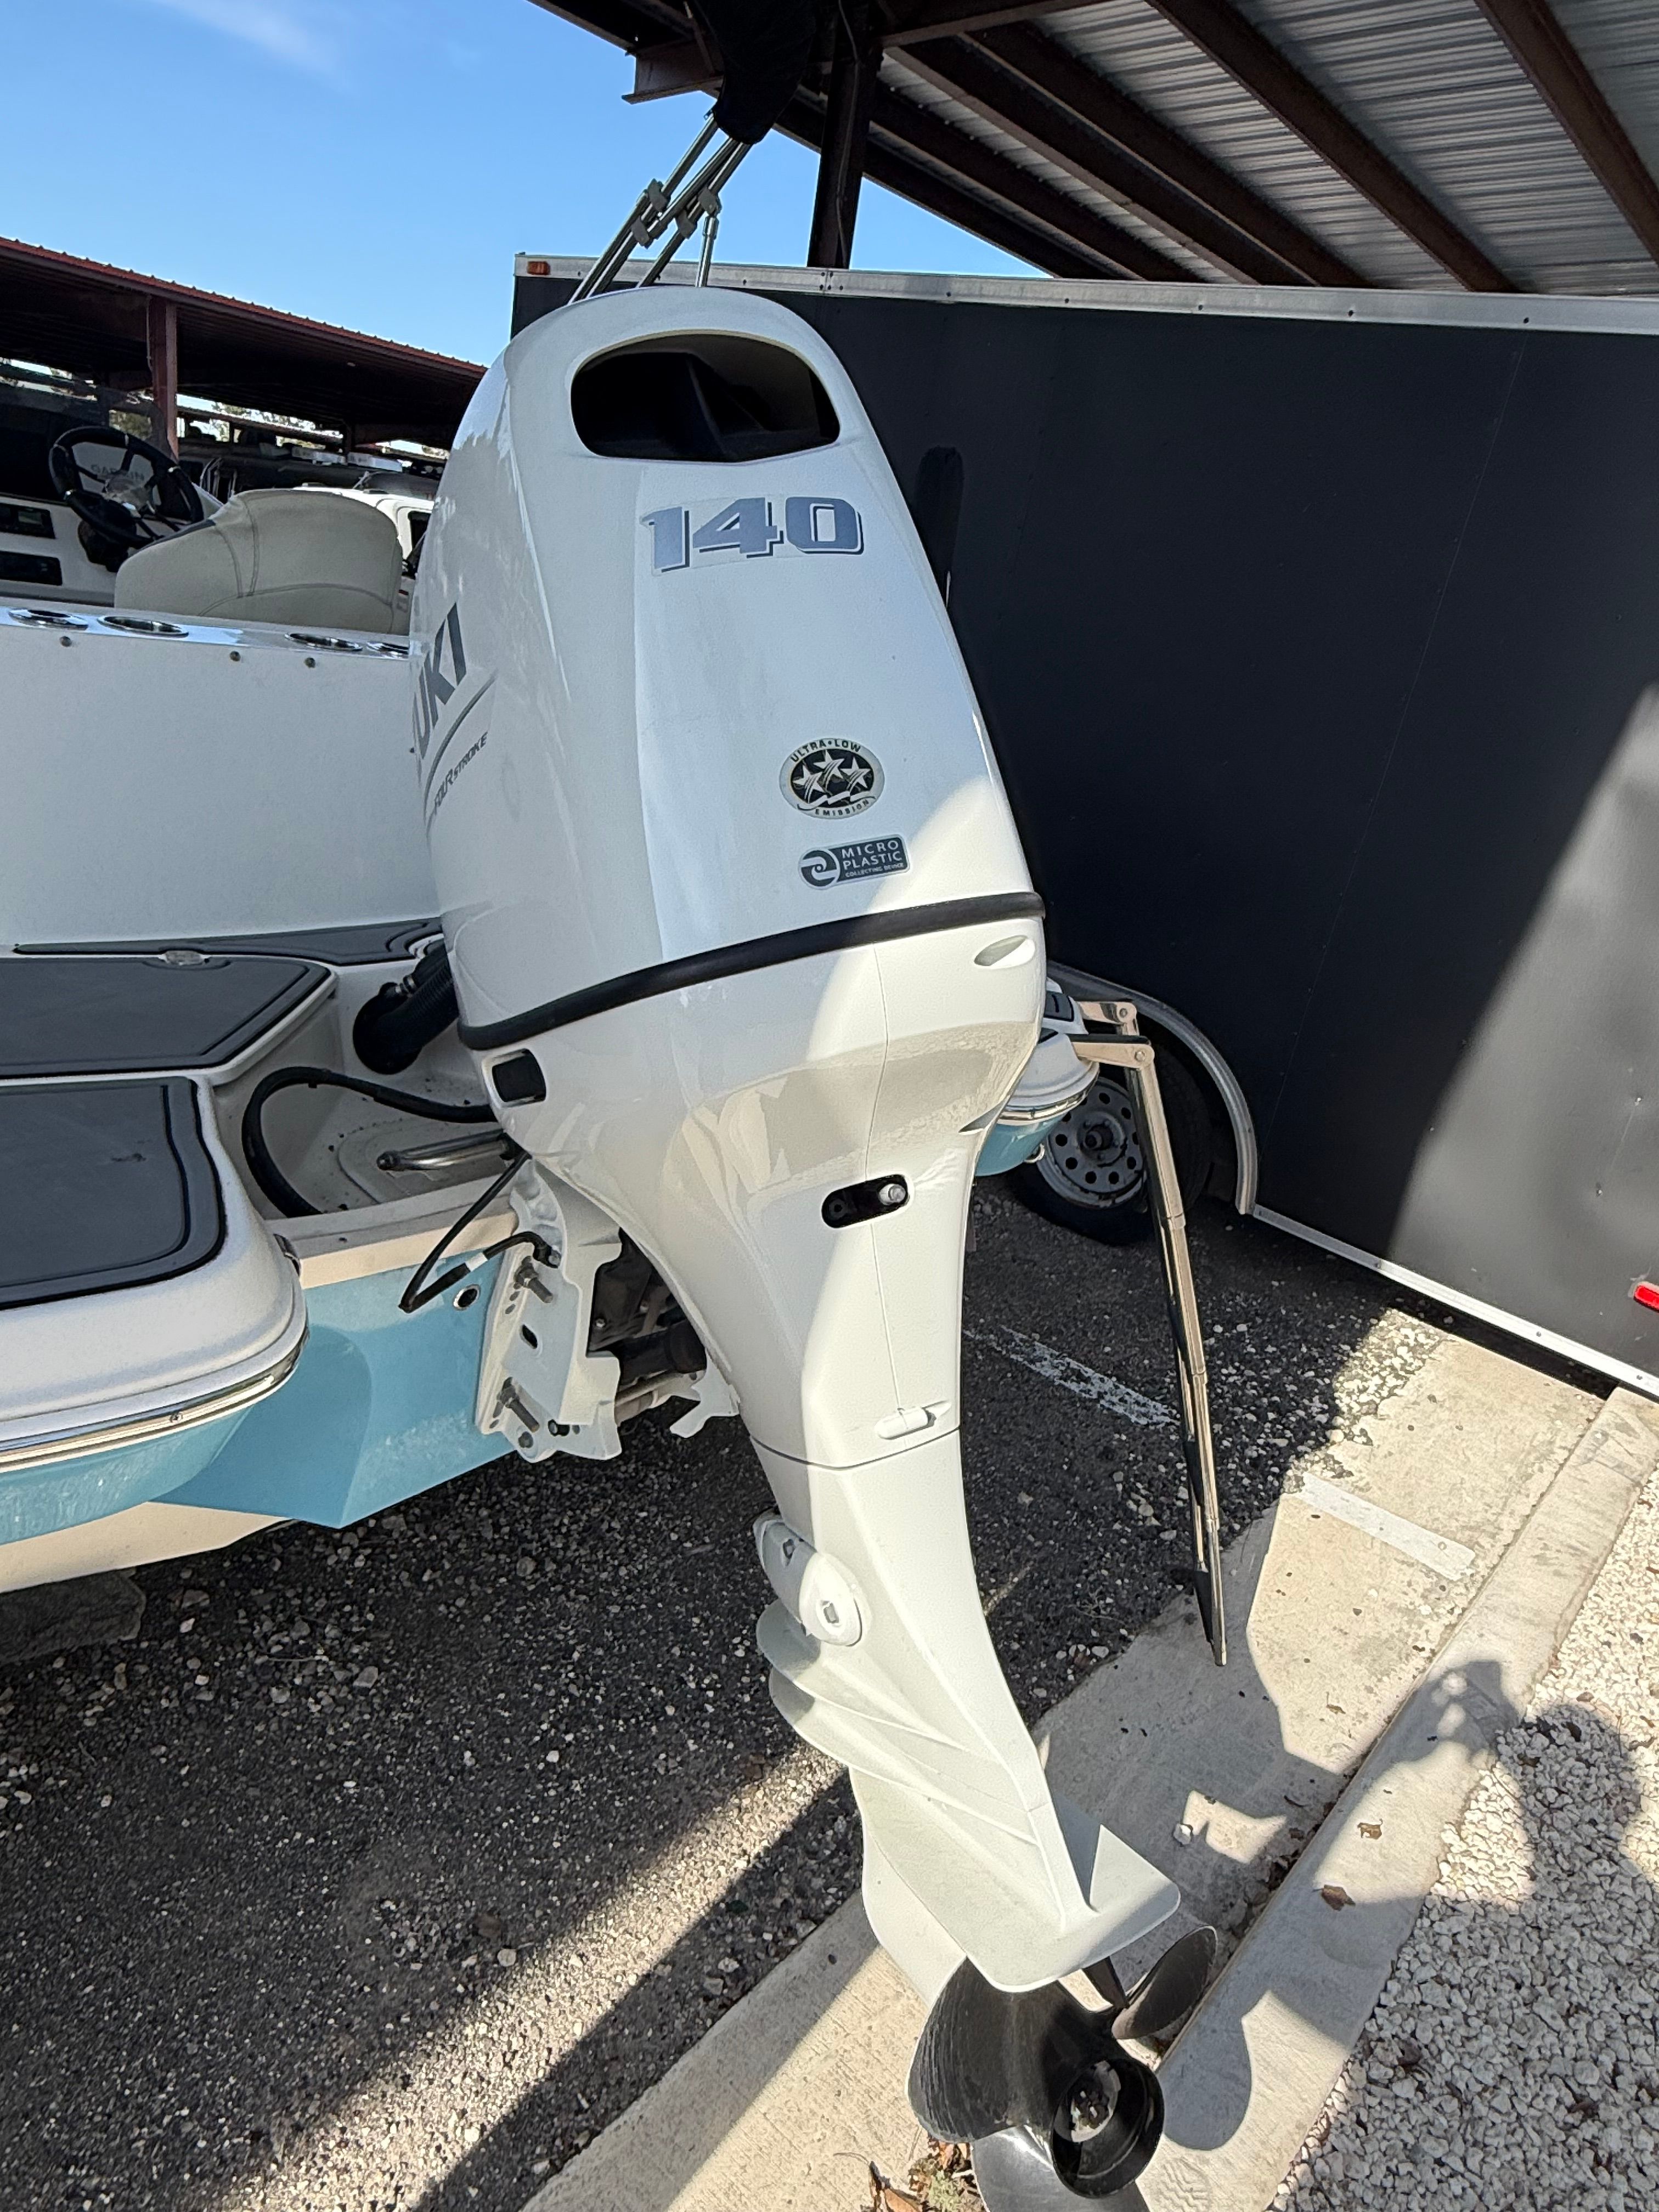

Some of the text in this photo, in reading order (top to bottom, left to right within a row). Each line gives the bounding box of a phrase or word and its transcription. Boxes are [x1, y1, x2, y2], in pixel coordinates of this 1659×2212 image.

[640, 496, 864, 573] 140
[413, 602, 466, 789] UKI
[815, 799, 869, 816] EMISSION
[842, 840, 899, 859] MICRO
[843, 850, 902, 870] PLASTIC
